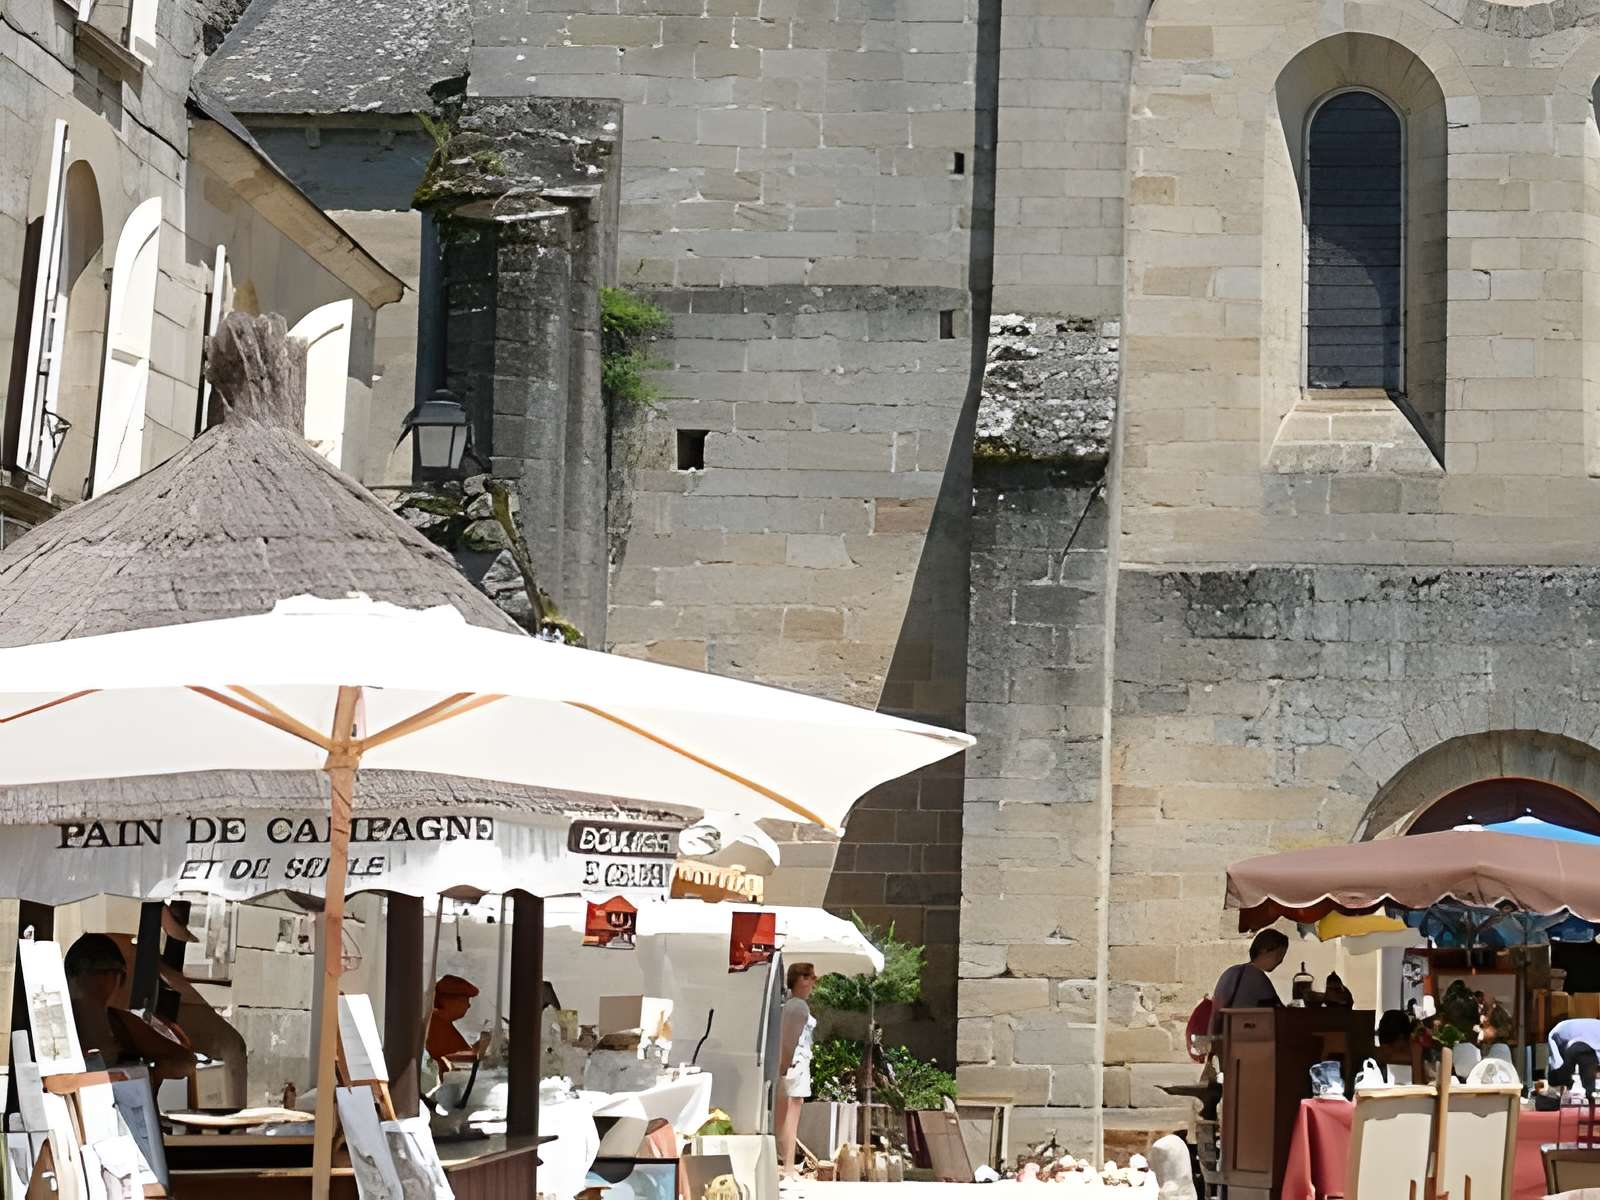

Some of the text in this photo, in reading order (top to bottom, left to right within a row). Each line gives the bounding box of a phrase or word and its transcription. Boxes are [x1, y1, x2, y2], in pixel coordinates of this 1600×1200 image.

[56, 818, 163, 849] PAIN
[186, 816, 246, 844] DE
[180, 858, 223, 880] ET
